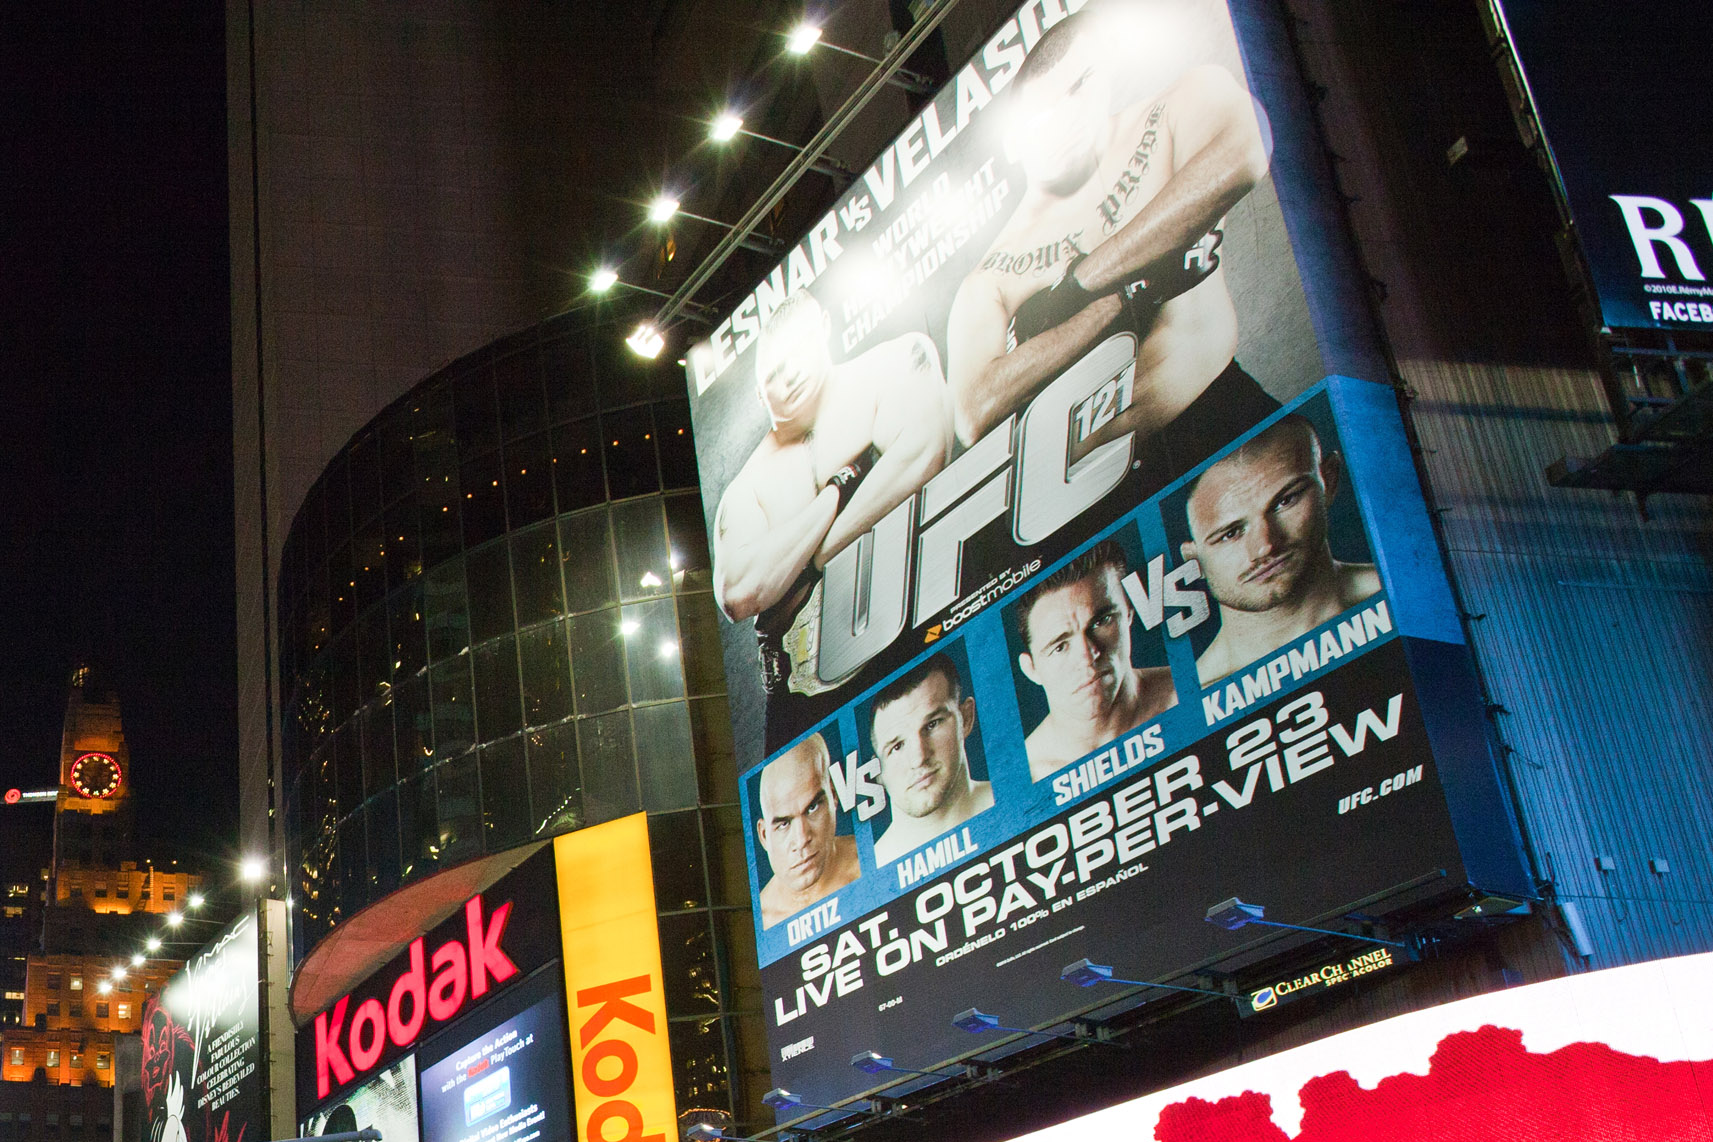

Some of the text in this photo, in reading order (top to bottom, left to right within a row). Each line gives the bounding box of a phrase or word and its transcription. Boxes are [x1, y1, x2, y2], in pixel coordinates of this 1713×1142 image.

[687, 207, 843, 397] LESNAR
[1074, 364, 1137, 440] 121
[818, 331, 1138, 681] UFC
[950, 567, 1011, 614] PRESENTED BY
[1122, 552, 1209, 640] VS
[1201, 600, 1393, 727] KAMPMANN
[828, 750, 886, 823] VS
[1051, 723, 1165, 807] SHIELDS
[1338, 764, 1423, 815] UFC.COM
[776, 961, 864, 1027] LIVE
[876, 923, 949, 984] ON
[962, 693, 1405, 937] PAY-PER-VIEW
[800, 911, 900, 982] SAT.
[915, 755, 1205, 924] OCTOBER
[1226, 691, 1332, 772] 23
[896, 827, 980, 891] HAMILL
[786, 897, 842, 948] ORTIZ
[935, 927, 1007, 968] ORDÉNELO
[1009, 908, 1049, 932] 100%
[1051, 896, 1074, 913] EN
[1076, 862, 1149, 902] ESPAÑOL
[314, 893, 519, 1098] Kodak
[197, 1037, 256, 1085] COLOUR COLLECTION
[206, 1057, 245, 1090] CELEBRATING
[210, 1035, 240, 1063] FABULOUS
[441, 1073, 466, 1093] with the
[456, 1030, 517, 1071] Capture Action
[197, 1084, 222, 1109] DISNEY'S
